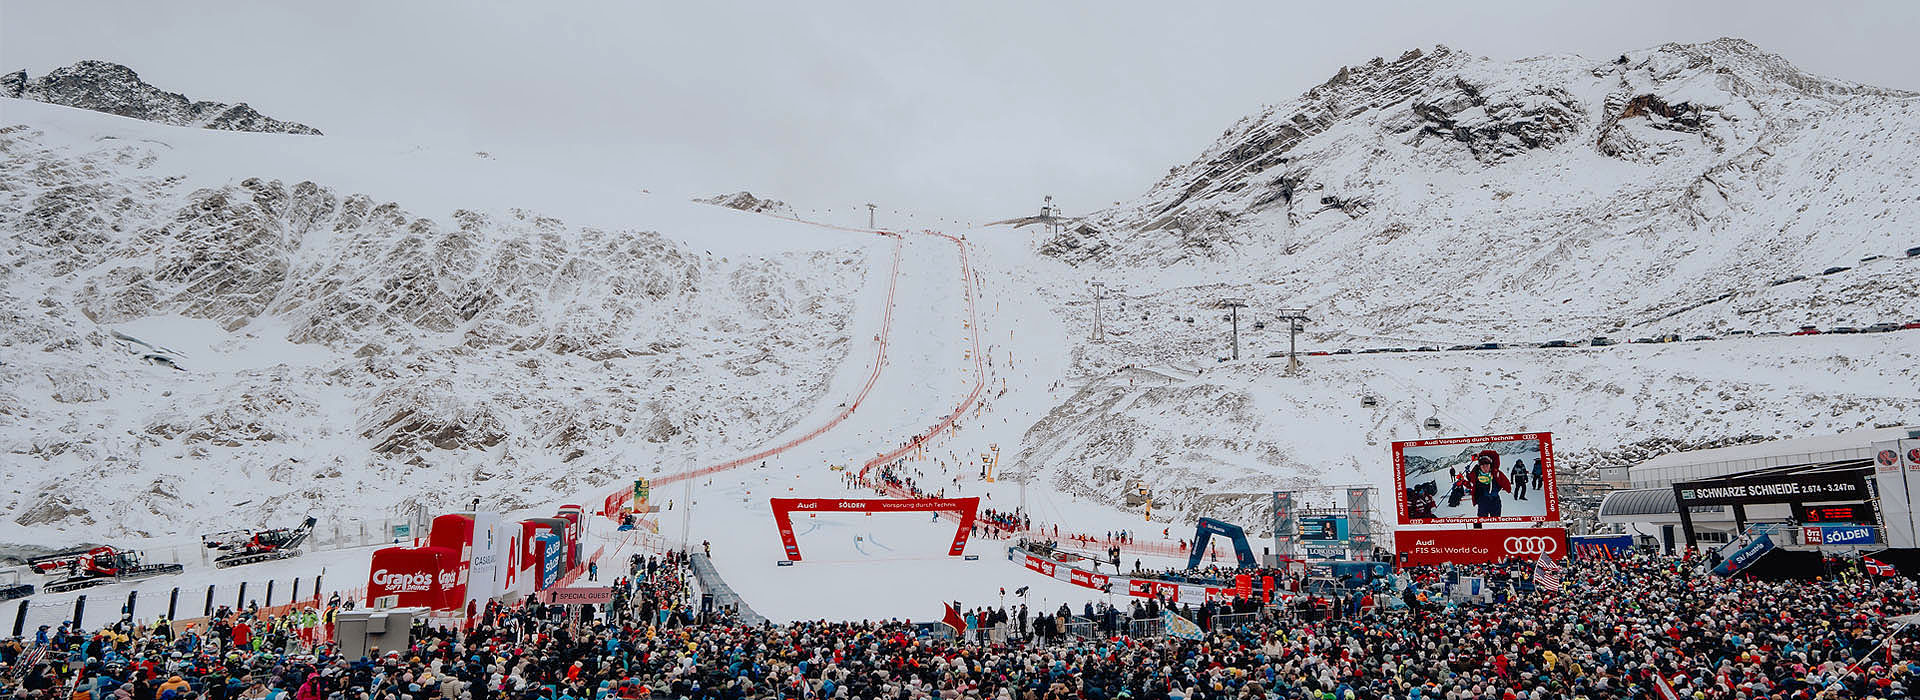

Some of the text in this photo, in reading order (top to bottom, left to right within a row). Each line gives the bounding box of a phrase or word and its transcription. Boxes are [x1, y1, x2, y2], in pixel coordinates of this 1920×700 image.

[1440, 438, 1471, 446] Vorsprung
[1697, 485, 1747, 499] SCHWARZE
[1748, 482, 1801, 496] SCHNEIDE
[1826, 528, 1869, 543] SÖLDEN
[1472, 547, 1488, 556] Cup
